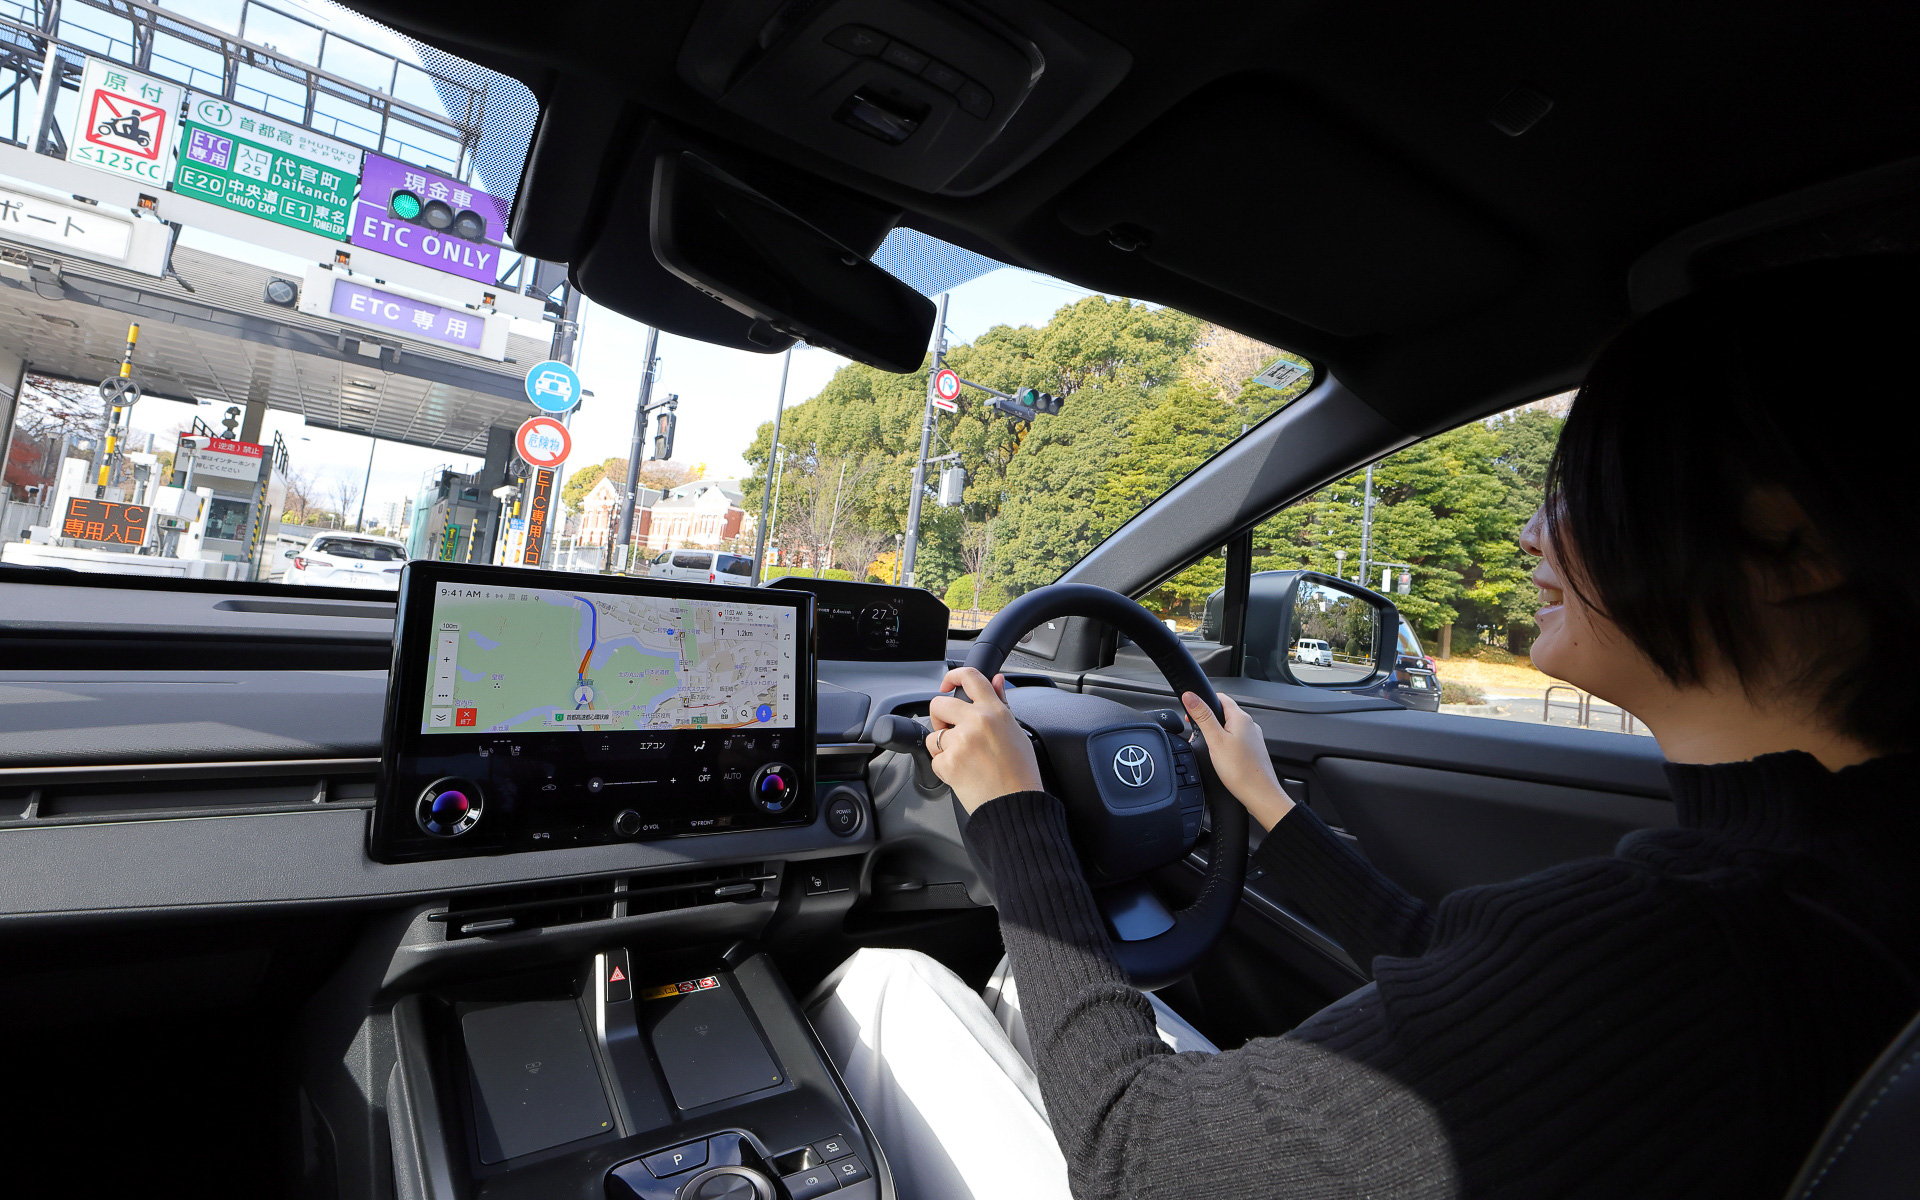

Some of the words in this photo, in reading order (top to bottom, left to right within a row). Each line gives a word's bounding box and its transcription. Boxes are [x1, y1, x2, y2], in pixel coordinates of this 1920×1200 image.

[103, 70, 164, 104] 原付
[204, 103, 224, 123] C1
[239, 116, 293, 147] 首都高
[193, 131, 228, 154] ETC
[299, 136, 357, 160] SHUTOKO
[190, 146, 226, 167] 専用
[240, 147, 268, 166] 入口
[241, 163, 262, 178] 25
[275, 156, 342, 192] 代官町
[183, 172, 221, 192] E20
[228, 178, 278, 206] 中央道
[271, 173, 348, 208] Daikancho
[403, 171, 474, 209] 現金車
[226, 192, 255, 211] CHUO
[257, 199, 277, 215] EXP
[284, 203, 308, 220] E1
[315, 204, 345, 225] 東名
[312, 217, 332, 233] TOMEI
[332, 221, 345, 236] EXP
[362, 216, 411, 249] ETC
[421, 233, 492, 271] ONLY
[350, 292, 401, 321] ETC
[411, 308, 468, 340] 専用
[527, 433, 560, 452] 危険物
[70, 498, 144, 524] ETC
[524, 470, 551, 565] ETC専用入口
[63, 518, 145, 545] 専用入口
[441, 588, 463, 598] 9:41
[465, 590, 481, 599] AM
[871, 608, 887, 620] 27
[737, 629, 753, 638] 1.2km
[640, 742, 666, 750] エアコン
[698, 774, 711, 783] OFF
[723, 772, 742, 780] AUTO
[697, 819, 714, 827] FRONT
[672, 1153, 683, 1166] P
